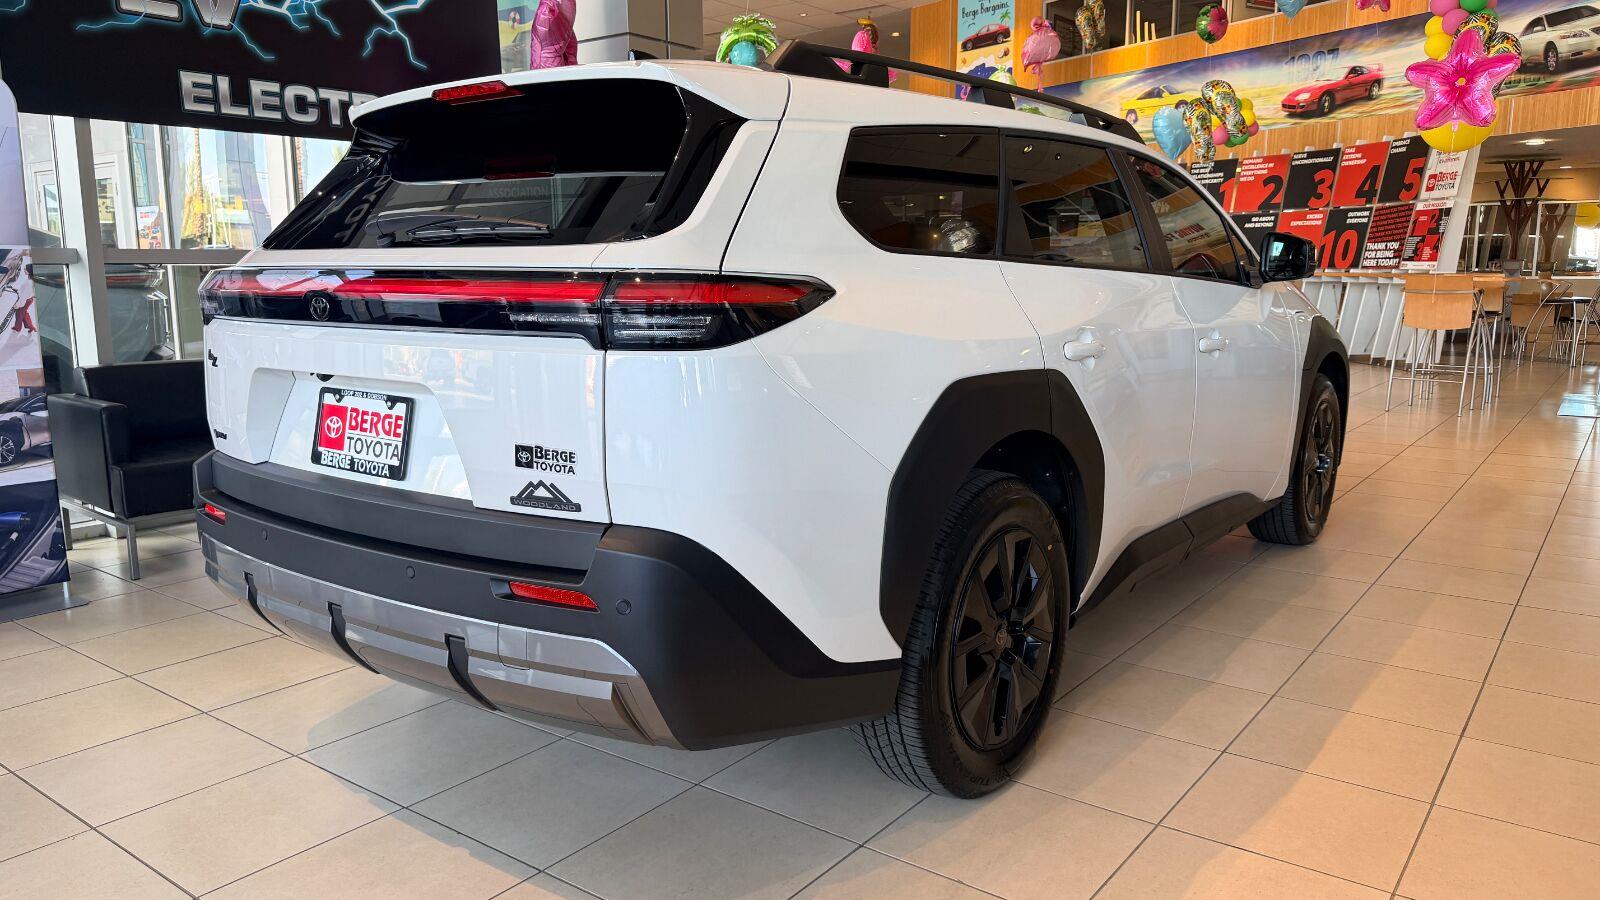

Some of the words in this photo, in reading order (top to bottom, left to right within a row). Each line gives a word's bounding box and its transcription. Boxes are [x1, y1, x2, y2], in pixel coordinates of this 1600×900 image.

[962, 8, 979, 20] Berge
[1392, 139, 1410, 147] EMBRACE
[1292, 157, 1334, 165] UNCONDITIONALLY
[1355, 164, 1381, 206] 4
[1398, 157, 1426, 201] 5
[1436, 171, 1458, 182] BERGE
[1257, 175, 1284, 211] 2
[1308, 169, 1334, 208] 3
[1435, 182, 1455, 190] TOYOTA
[1320, 230, 1358, 269] 10
[1376, 250, 1394, 258] BEING
[348, 407, 403, 438] BERGE
[347, 436, 400, 461] TOYOTA
[534, 446, 576, 463] BERGE
[321, 450, 352, 469] BERGE
[354, 459, 389, 477] TOYOTA
[534, 461, 575, 474] TOYOTA
[514, 499, 576, 510] WOODLAND
